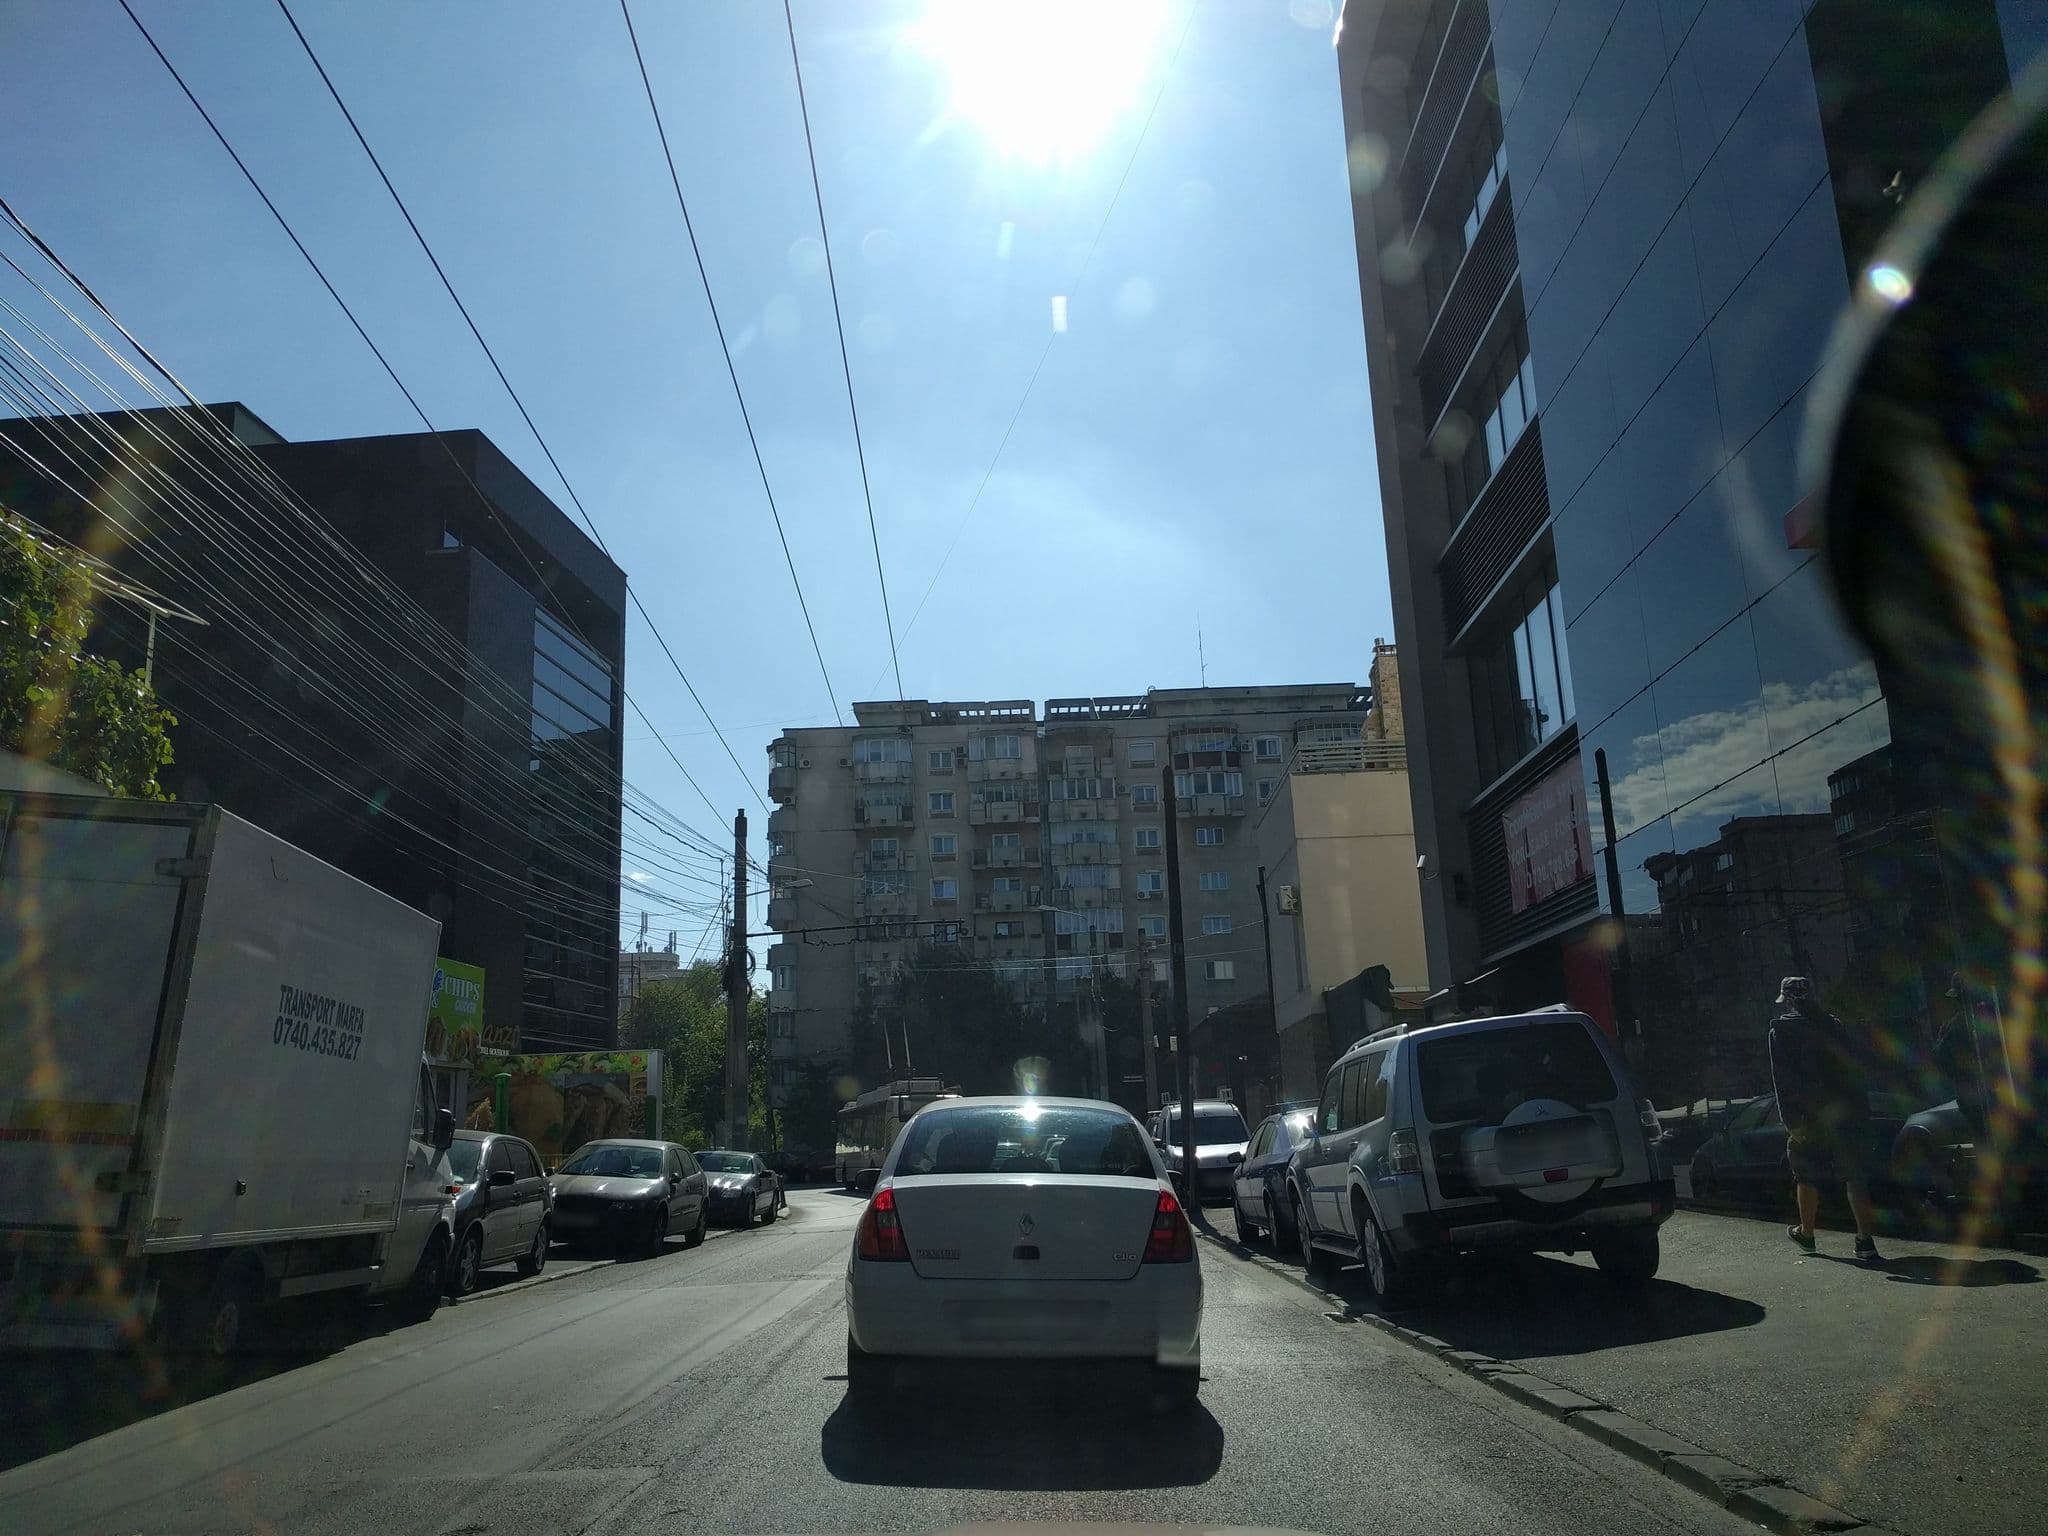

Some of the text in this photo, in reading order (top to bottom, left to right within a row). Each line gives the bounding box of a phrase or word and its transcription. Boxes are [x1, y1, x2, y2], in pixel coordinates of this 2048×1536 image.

[279, 983, 365, 1034] TRANSPORT MARFA
[273, 1015, 362, 1061] 0740.435.827
